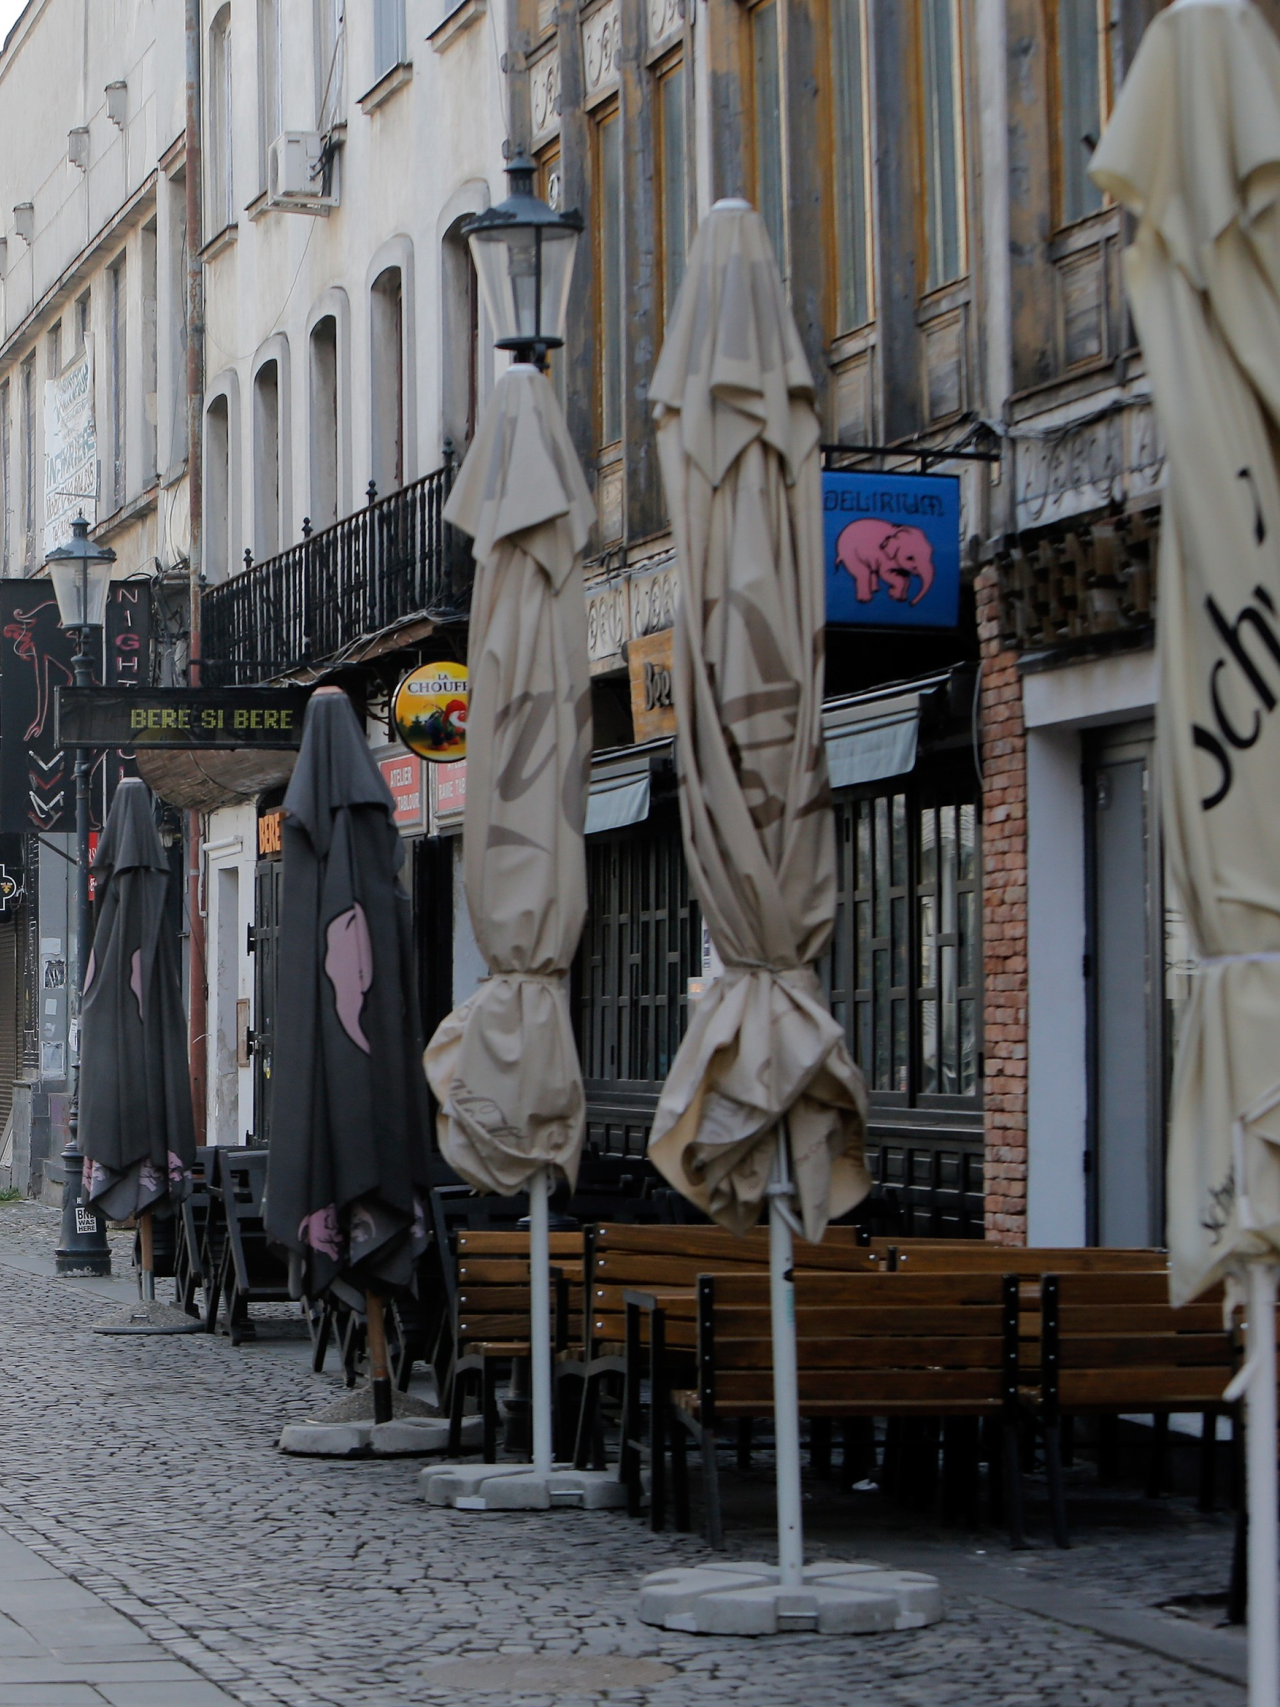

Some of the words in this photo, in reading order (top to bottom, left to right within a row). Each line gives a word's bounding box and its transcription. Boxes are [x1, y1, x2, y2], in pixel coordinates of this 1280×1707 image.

[823, 489, 945, 517] DELIRIUM
[407, 681, 467, 694] CHOUF
[131, 709, 191, 729] BERE
[201, 709, 224, 729] SI
[233, 709, 294, 729] BERE
[390, 766, 412, 788] ATELIER
[258, 812, 281, 855] BERE
